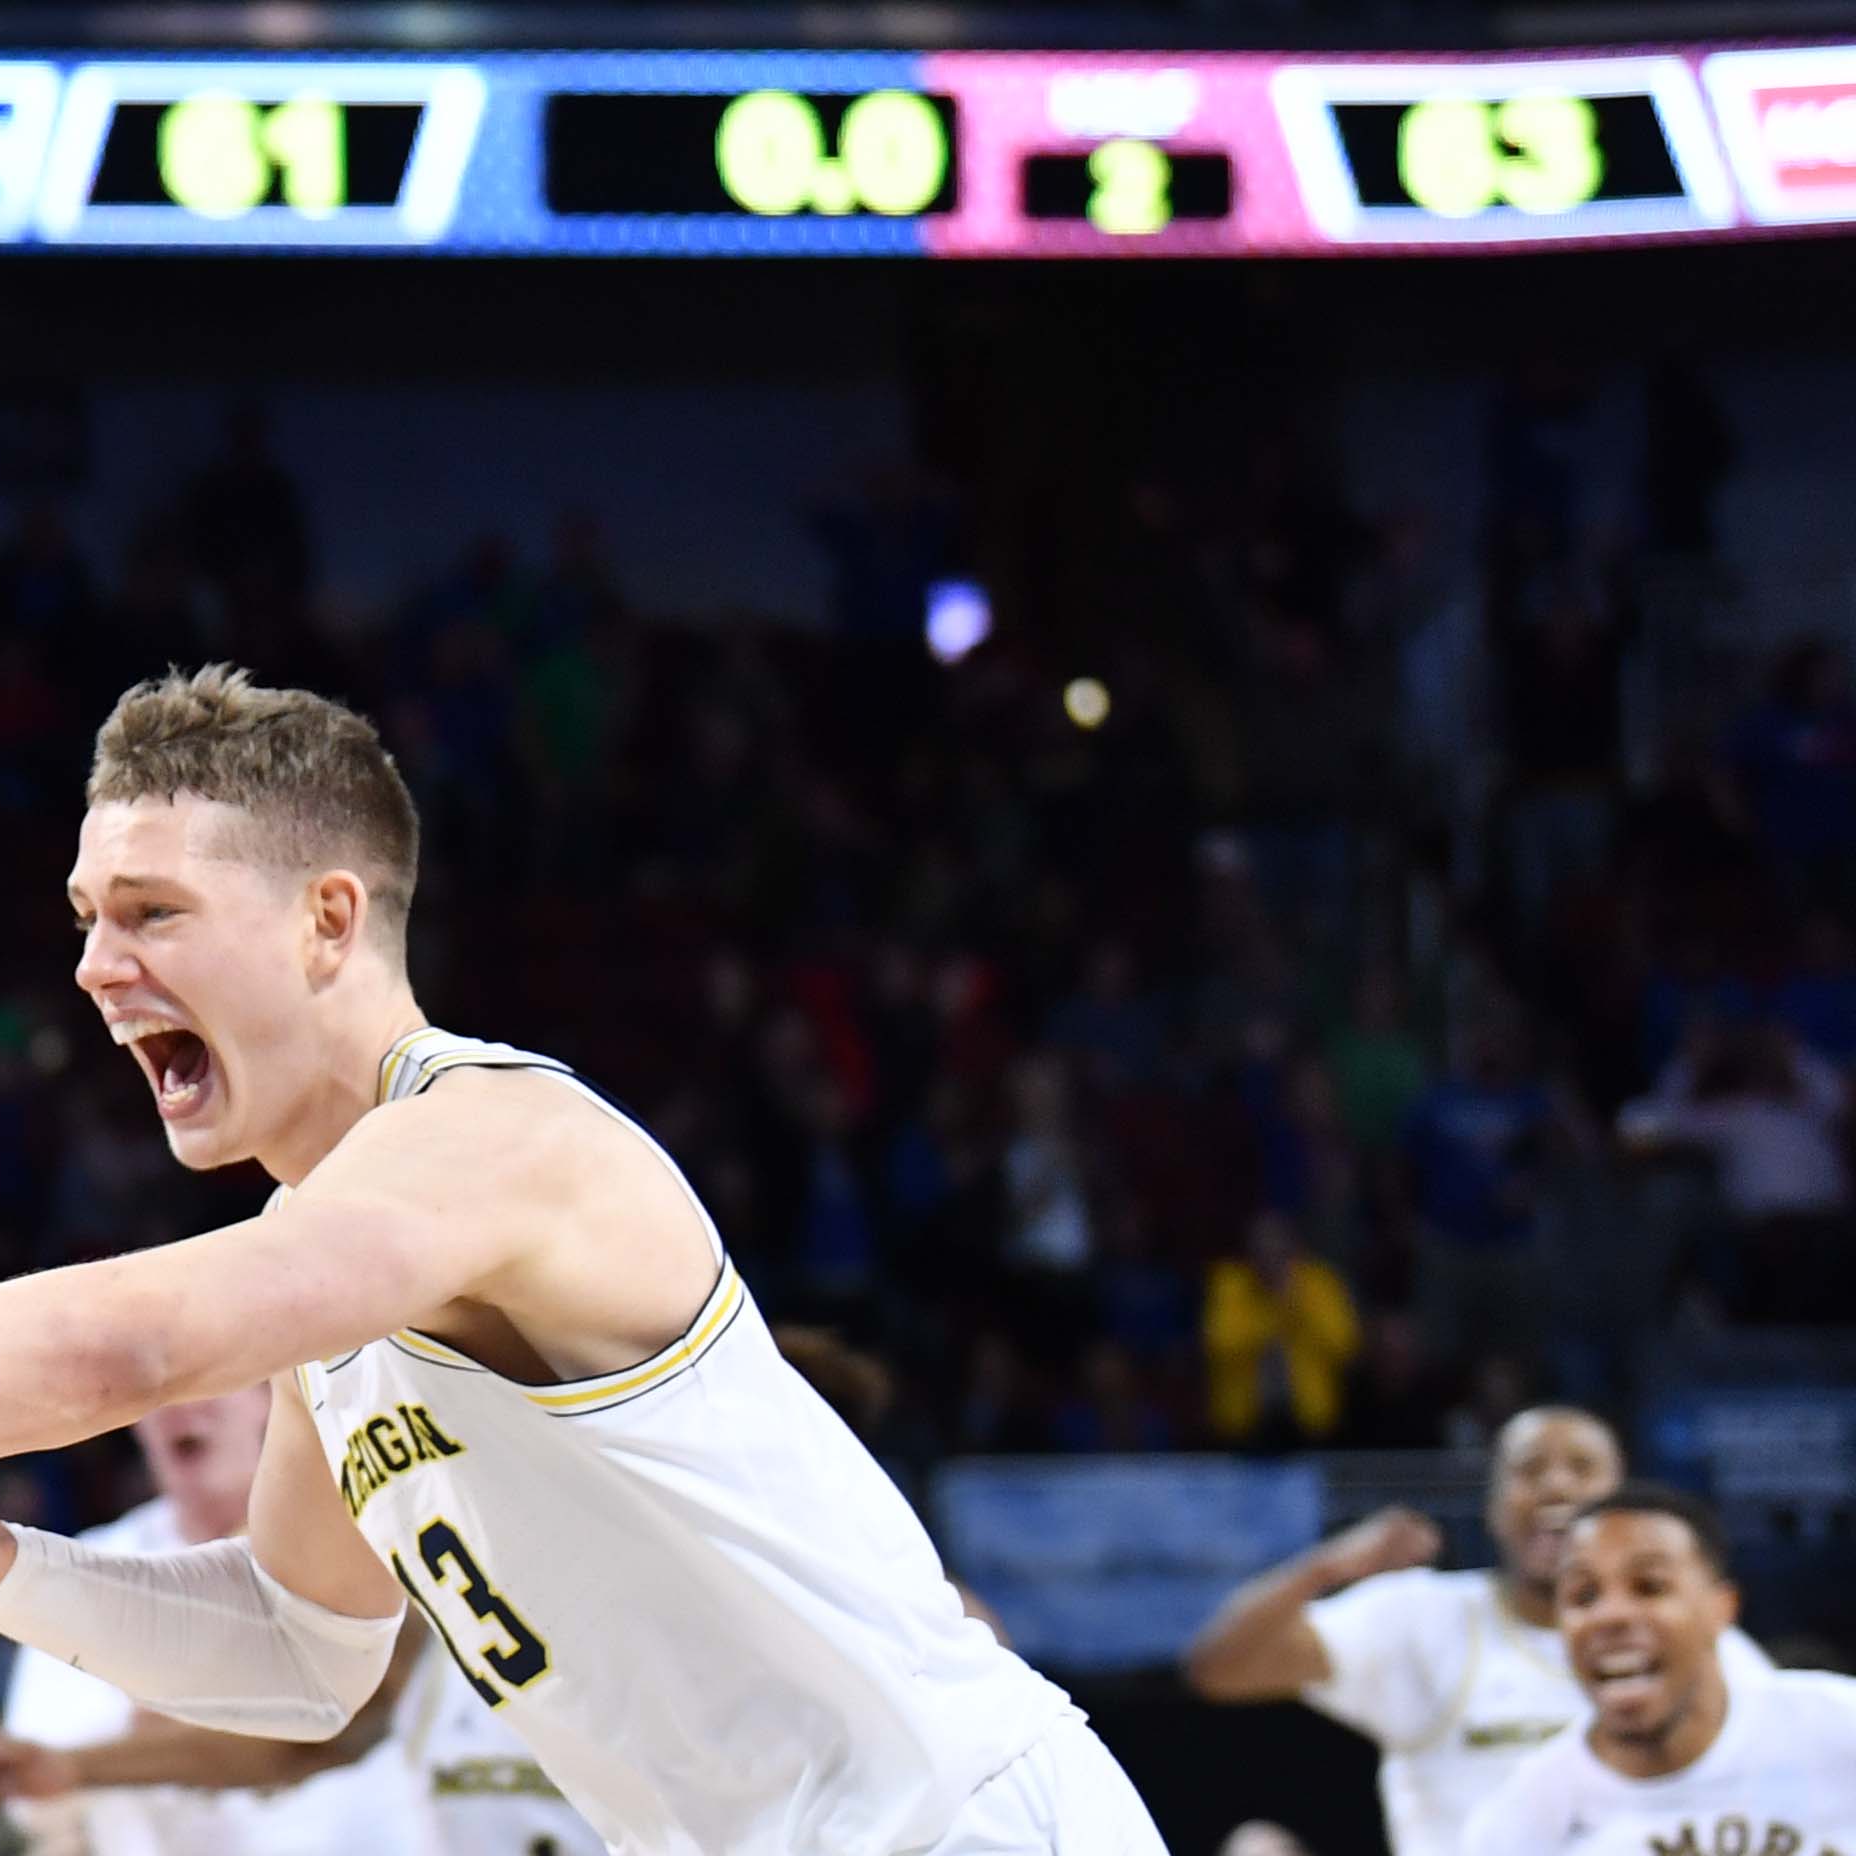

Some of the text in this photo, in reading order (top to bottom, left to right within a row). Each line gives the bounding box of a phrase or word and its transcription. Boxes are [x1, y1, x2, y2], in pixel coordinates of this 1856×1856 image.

[158, 92, 348, 220] 61
[716, 88, 948, 216] 0.0
[1398, 92, 1604, 218] 63
